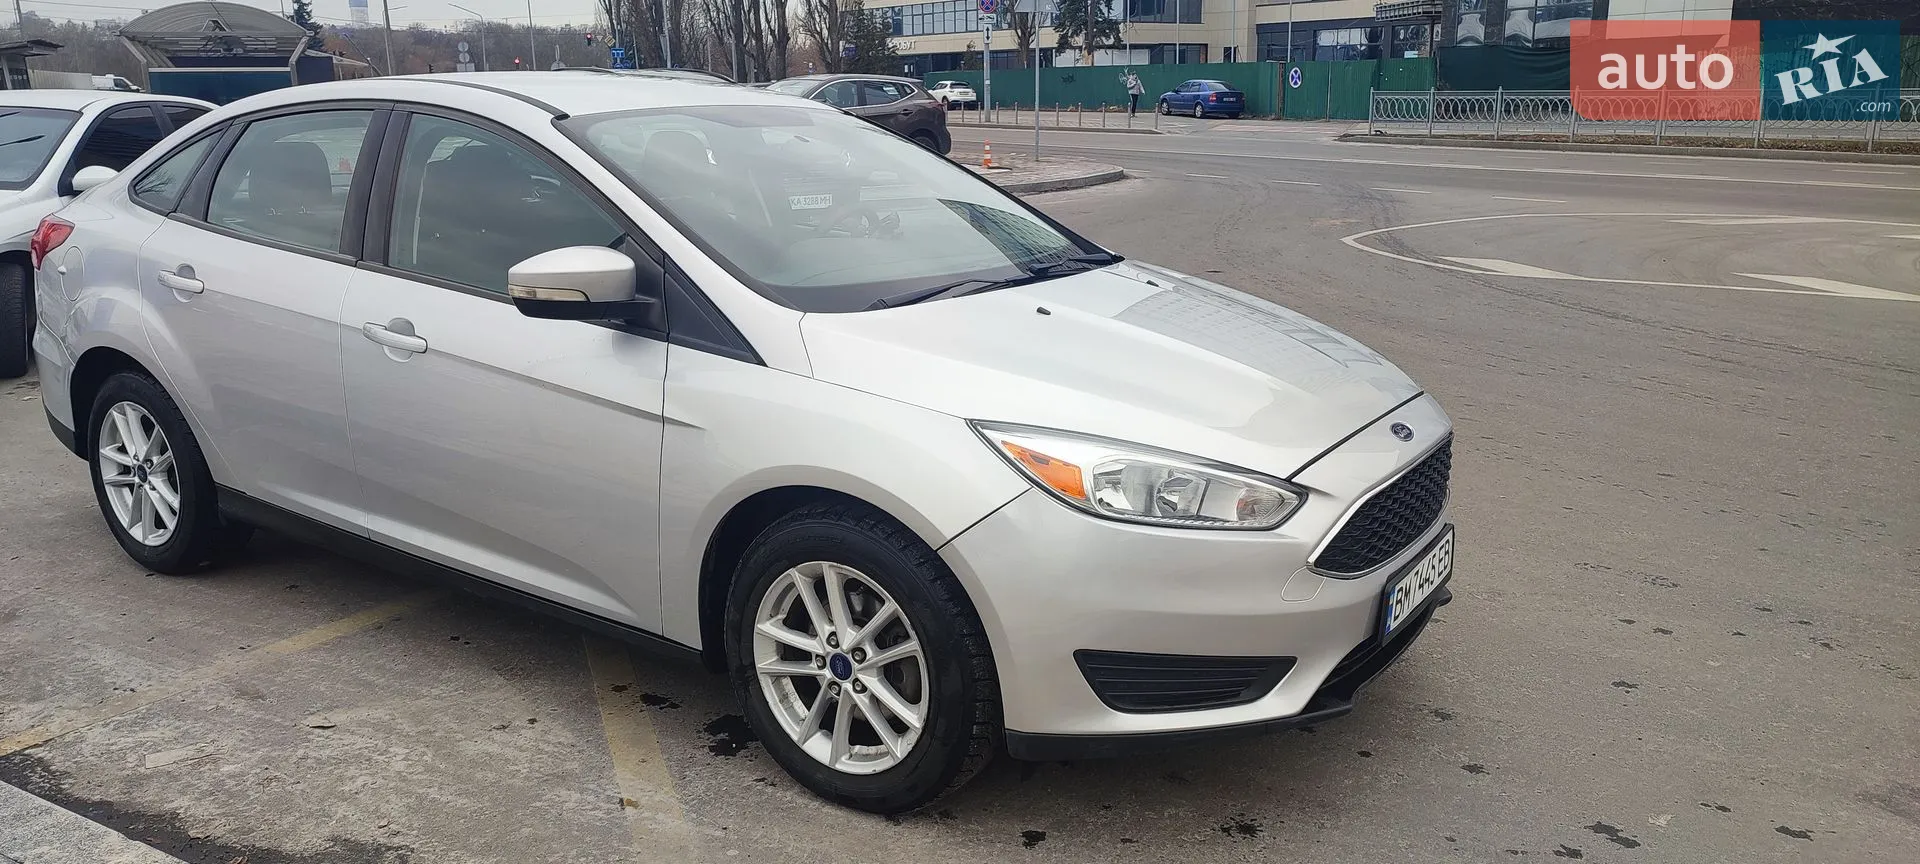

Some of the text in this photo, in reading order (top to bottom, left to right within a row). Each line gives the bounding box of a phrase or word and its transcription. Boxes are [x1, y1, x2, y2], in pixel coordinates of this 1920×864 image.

[1393, 538, 1450, 622] BM 7445 EB
